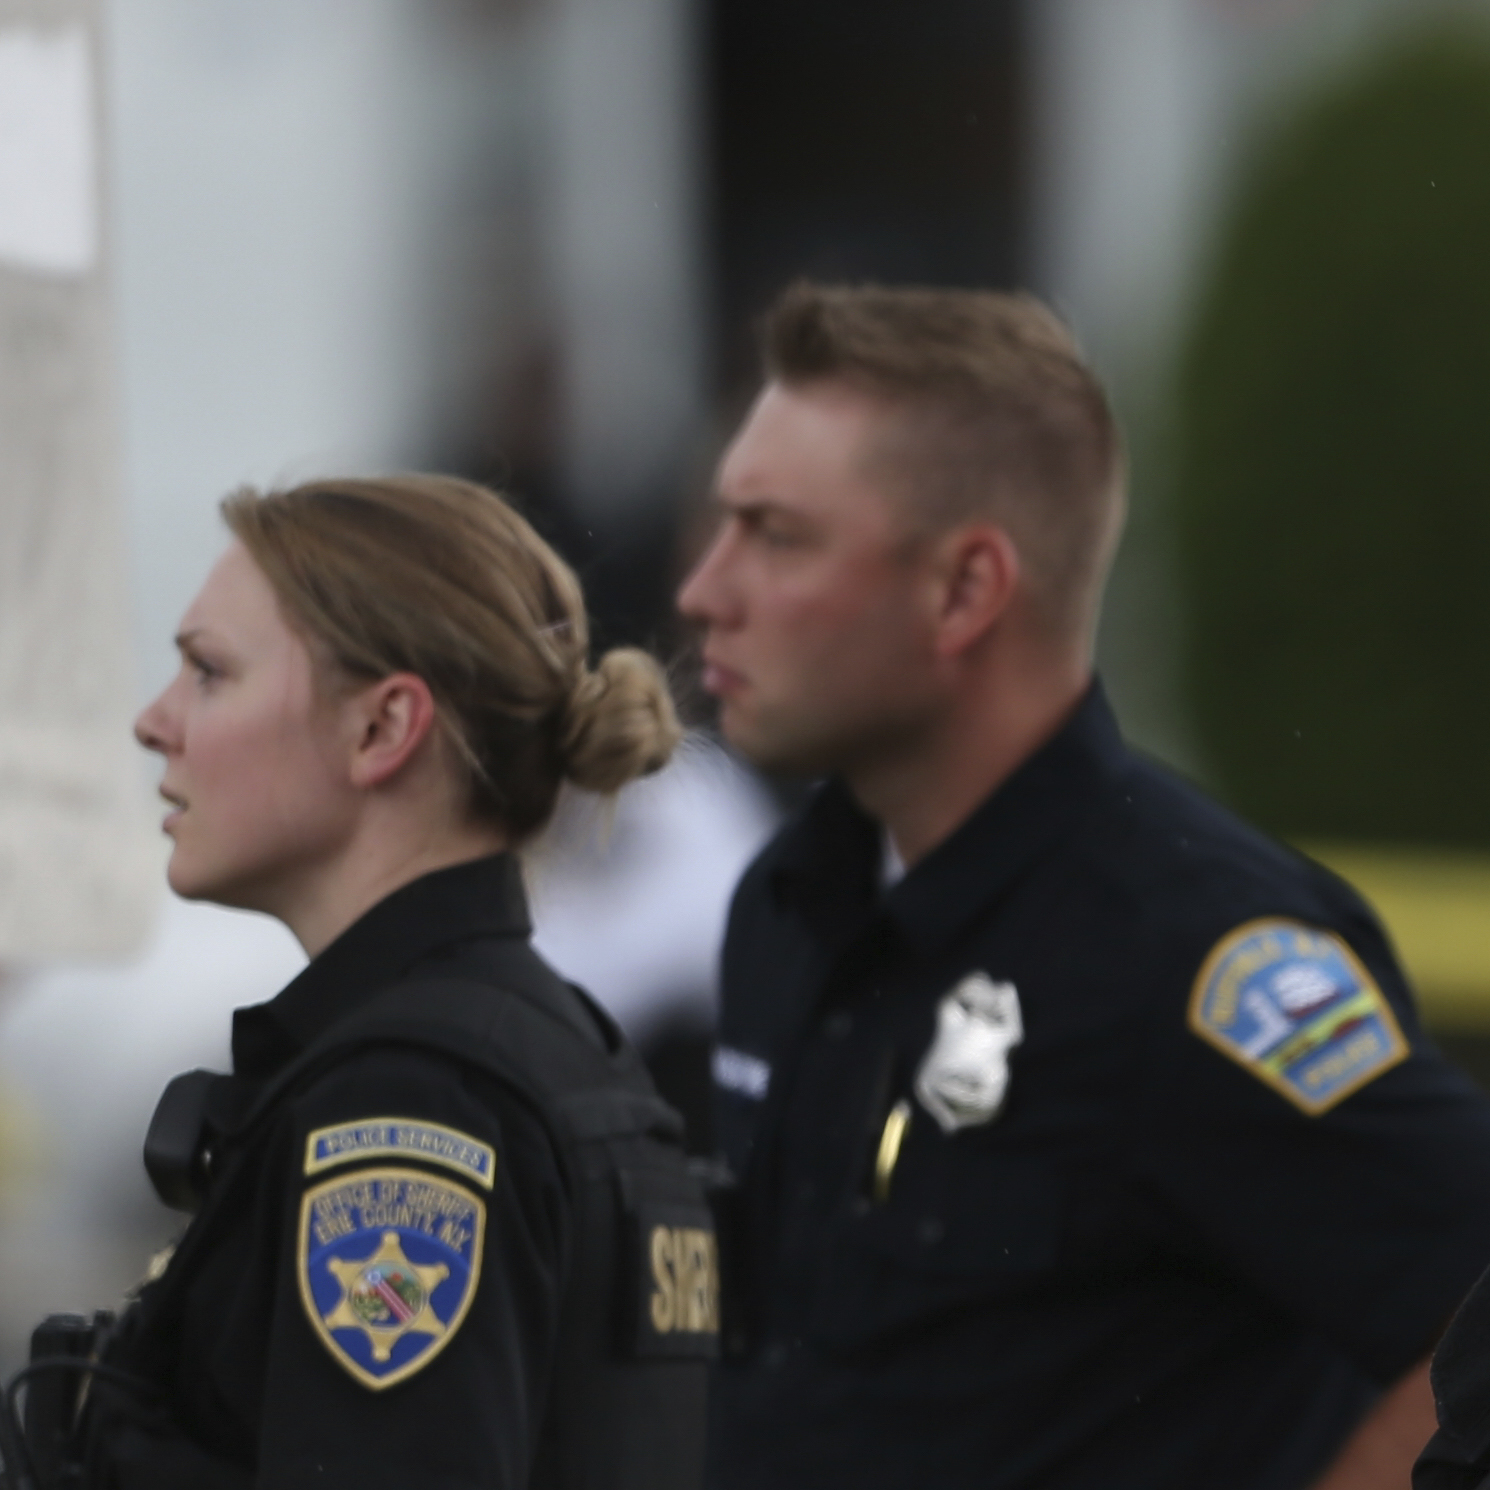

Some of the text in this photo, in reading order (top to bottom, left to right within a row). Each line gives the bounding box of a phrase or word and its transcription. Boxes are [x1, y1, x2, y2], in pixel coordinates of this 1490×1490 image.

[324, 1127, 484, 1167] POLICE SERVICES
[314, 1179, 472, 1223] OFFICE OF SHERIFF
[315, 1214, 358, 1246] ERIE
